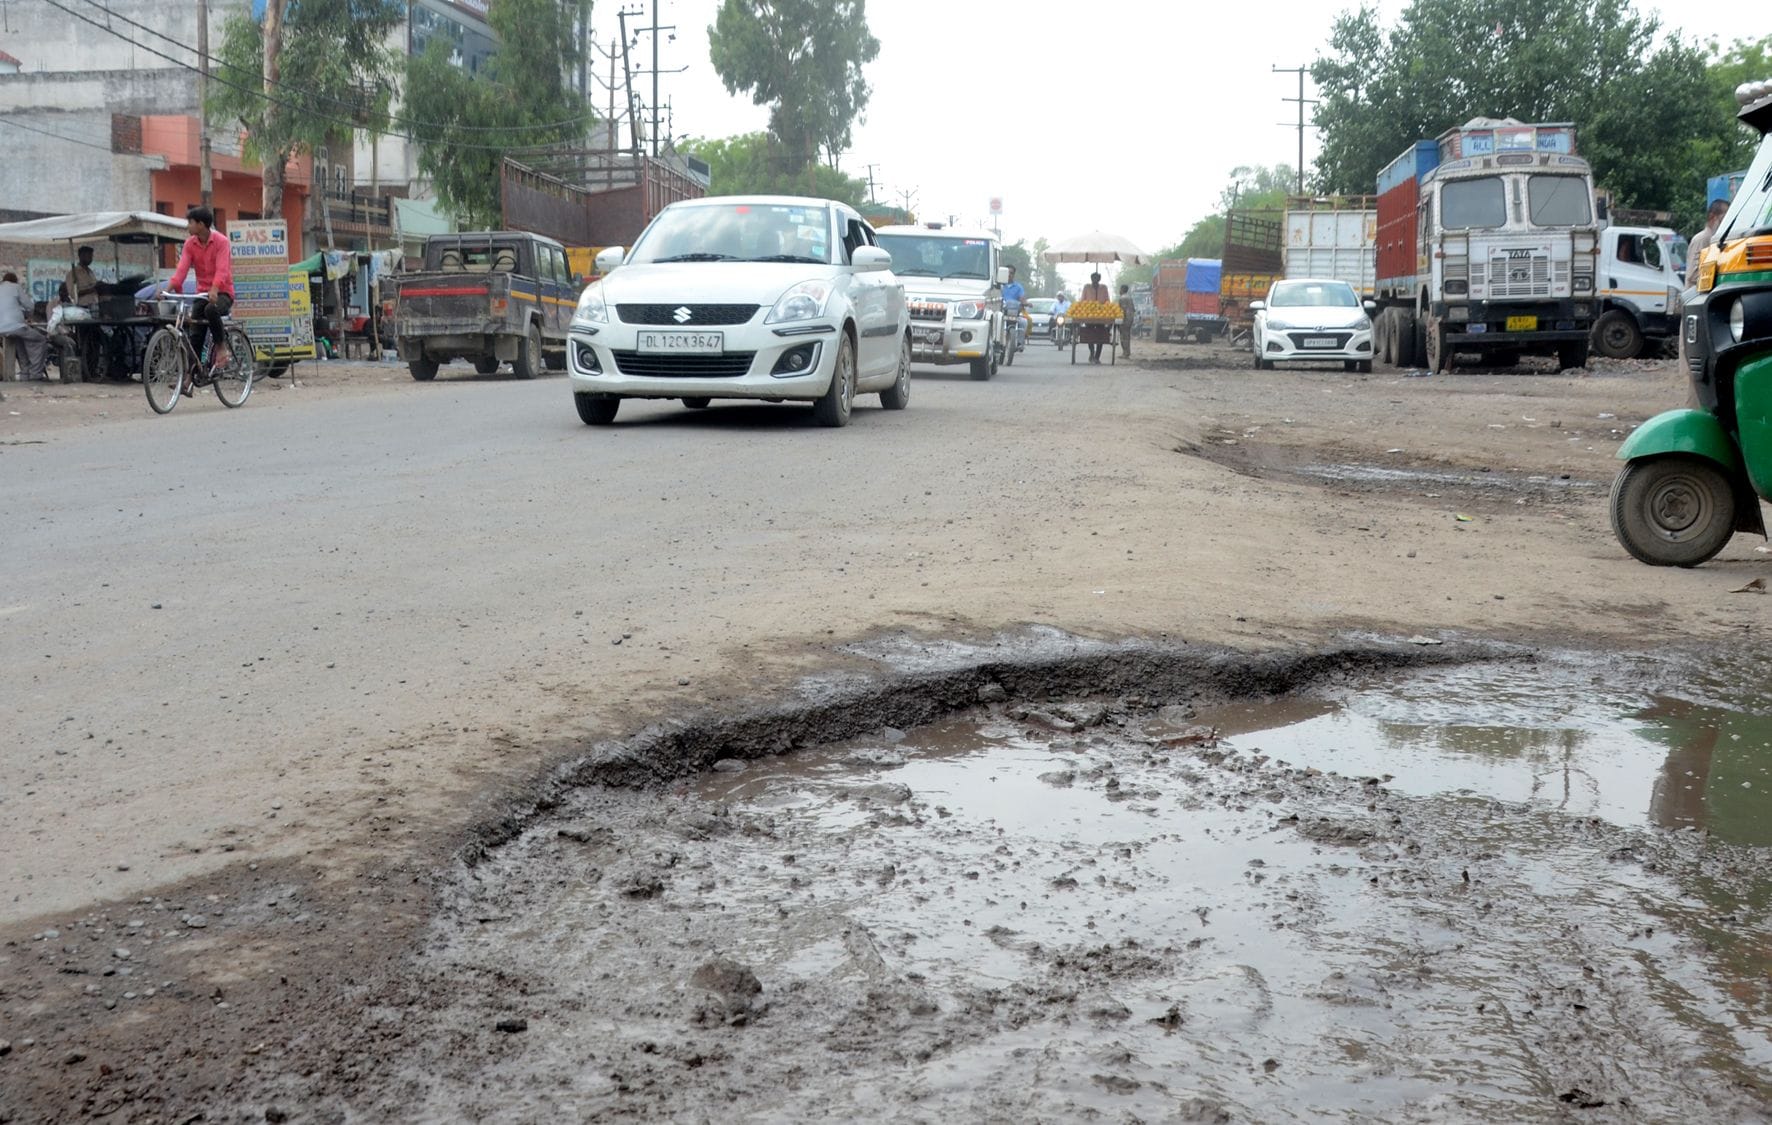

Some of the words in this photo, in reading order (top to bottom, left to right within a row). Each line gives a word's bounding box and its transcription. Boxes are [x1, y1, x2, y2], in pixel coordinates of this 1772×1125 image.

[1473, 141, 1491, 151] ALL
[246, 229, 268, 244] MS
[231, 245, 256, 257] CYBER
[257, 244, 285, 256] WORLD
[1508, 249, 1531, 259] TATA
